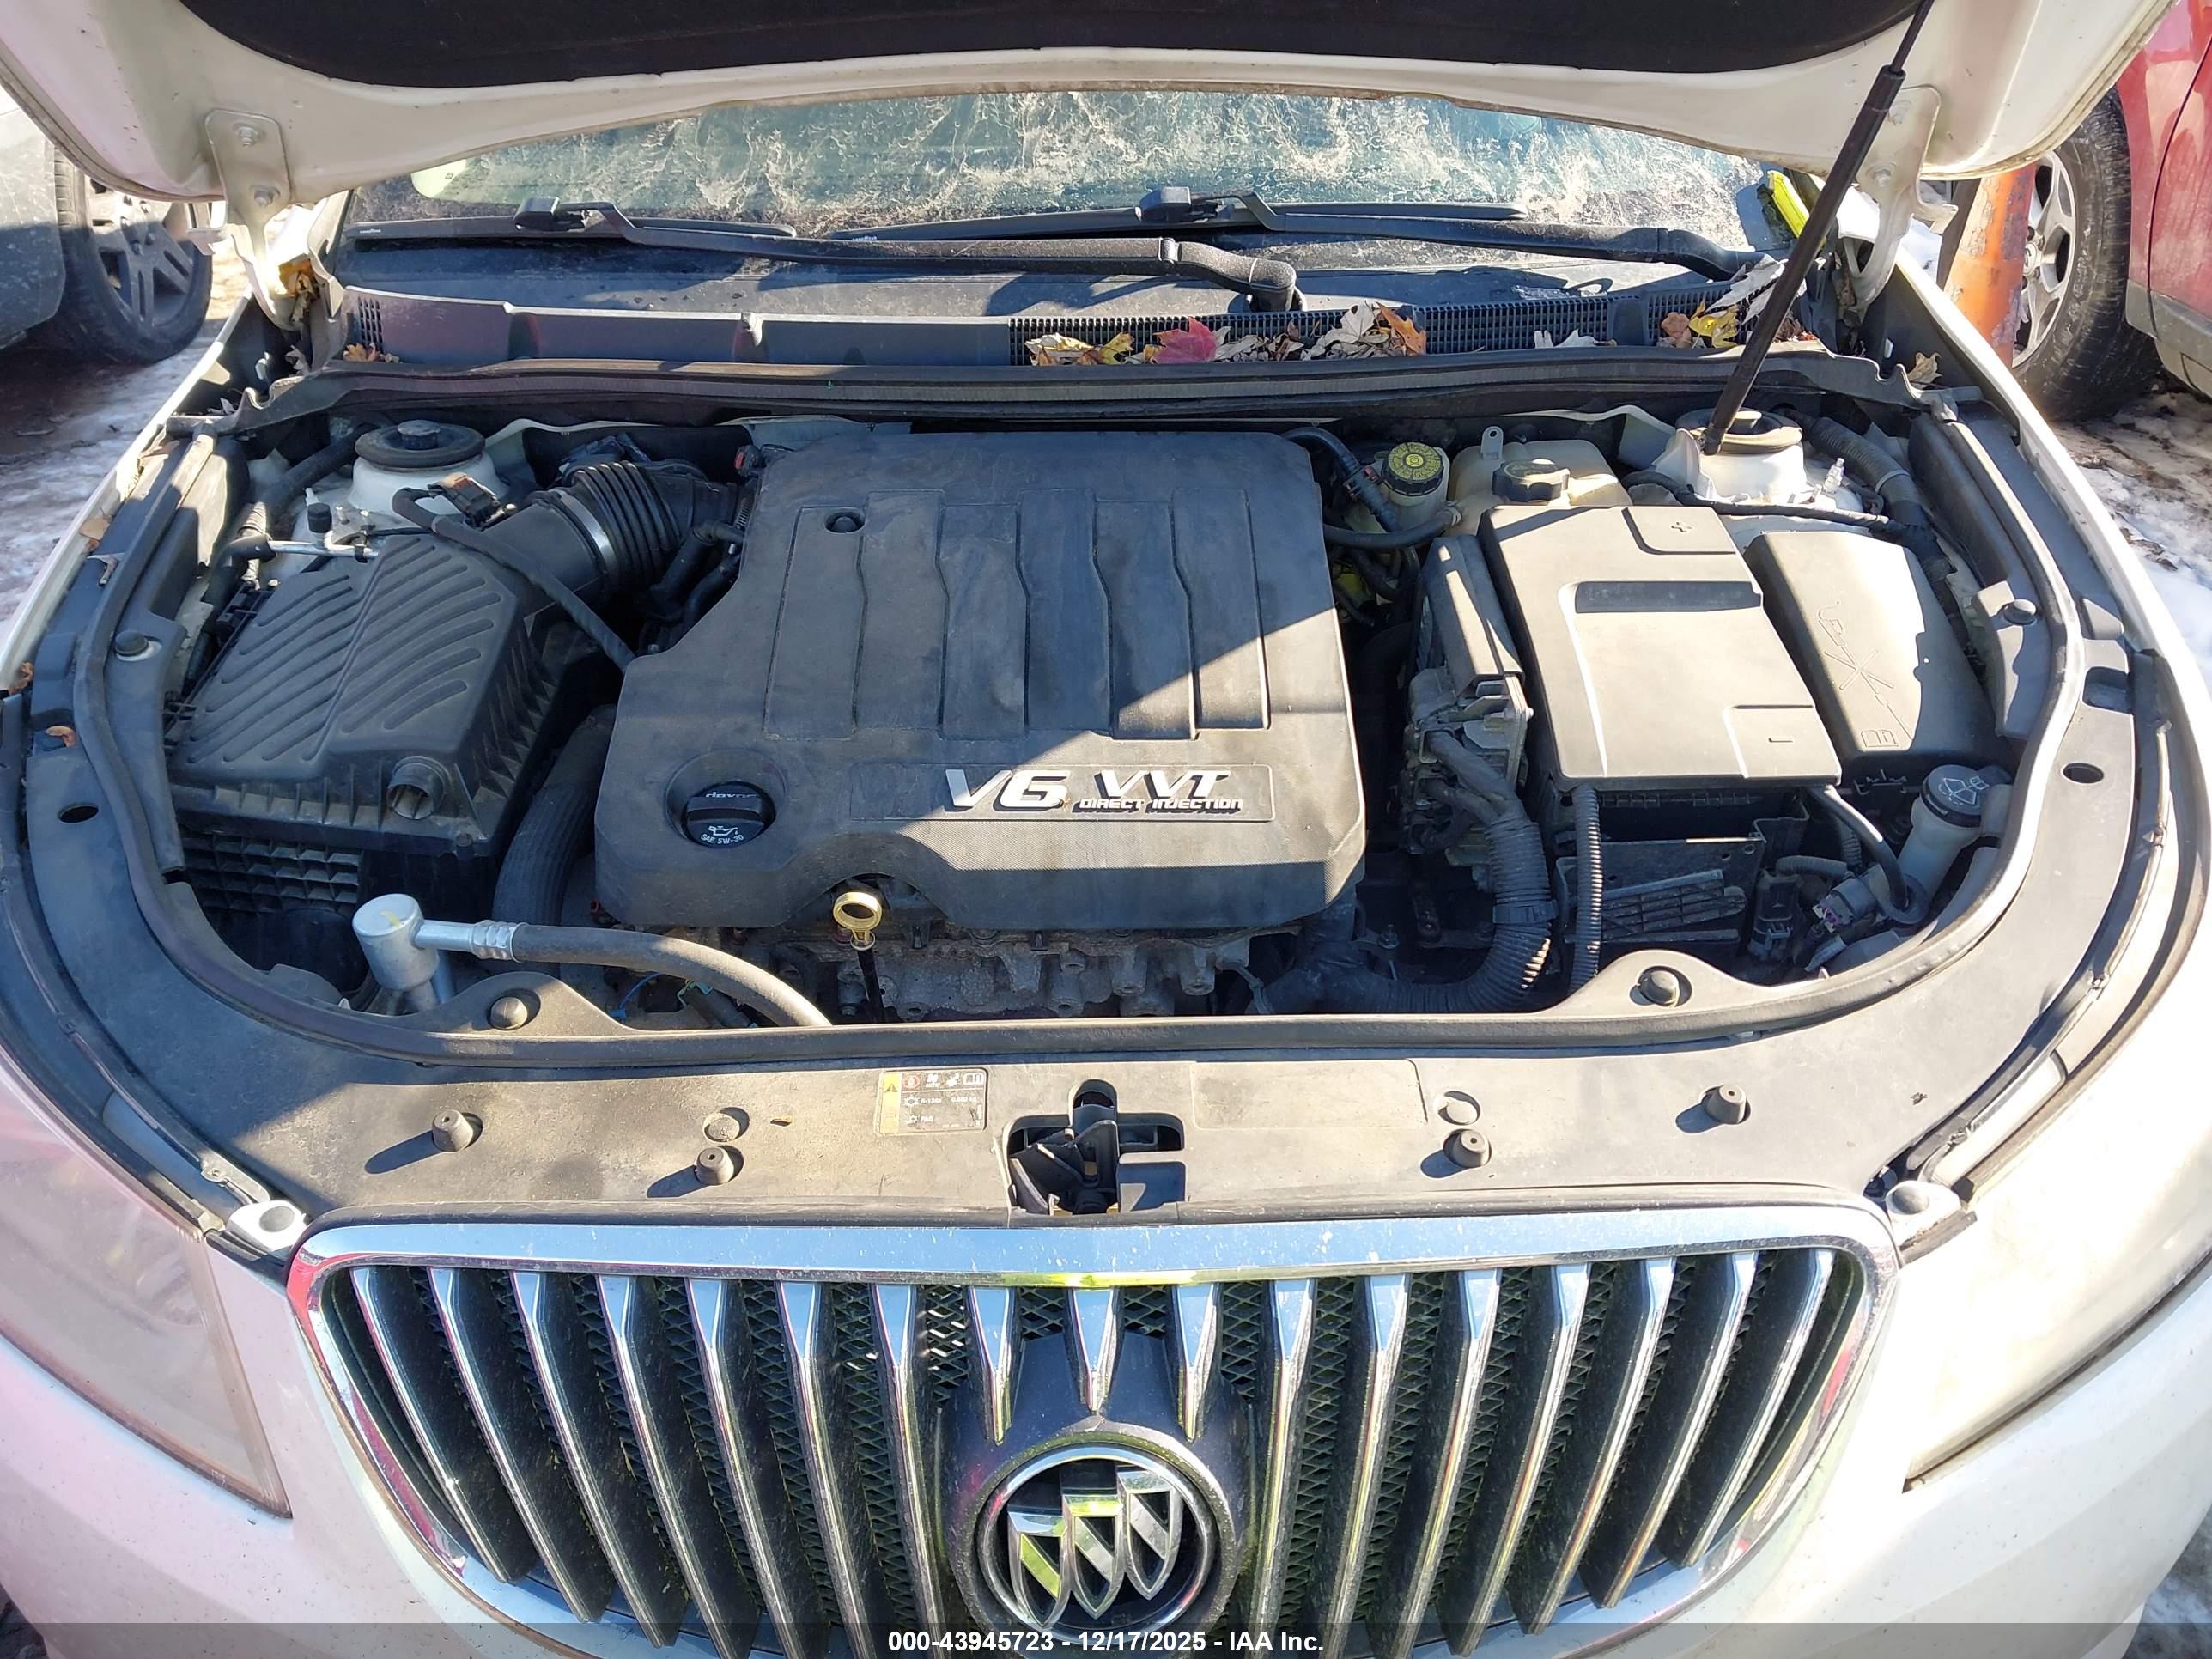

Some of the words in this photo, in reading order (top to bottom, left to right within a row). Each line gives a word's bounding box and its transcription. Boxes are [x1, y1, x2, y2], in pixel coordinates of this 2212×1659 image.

[945, 769, 1070, 811] V6
[1094, 769, 1231, 799] VVT
[1074, 798, 1145, 811] DIRECT
[1147, 798, 1243, 812] INJECTION
[700, 833, 715, 843] SAE
[717, 834, 744, 844] 5W-30
